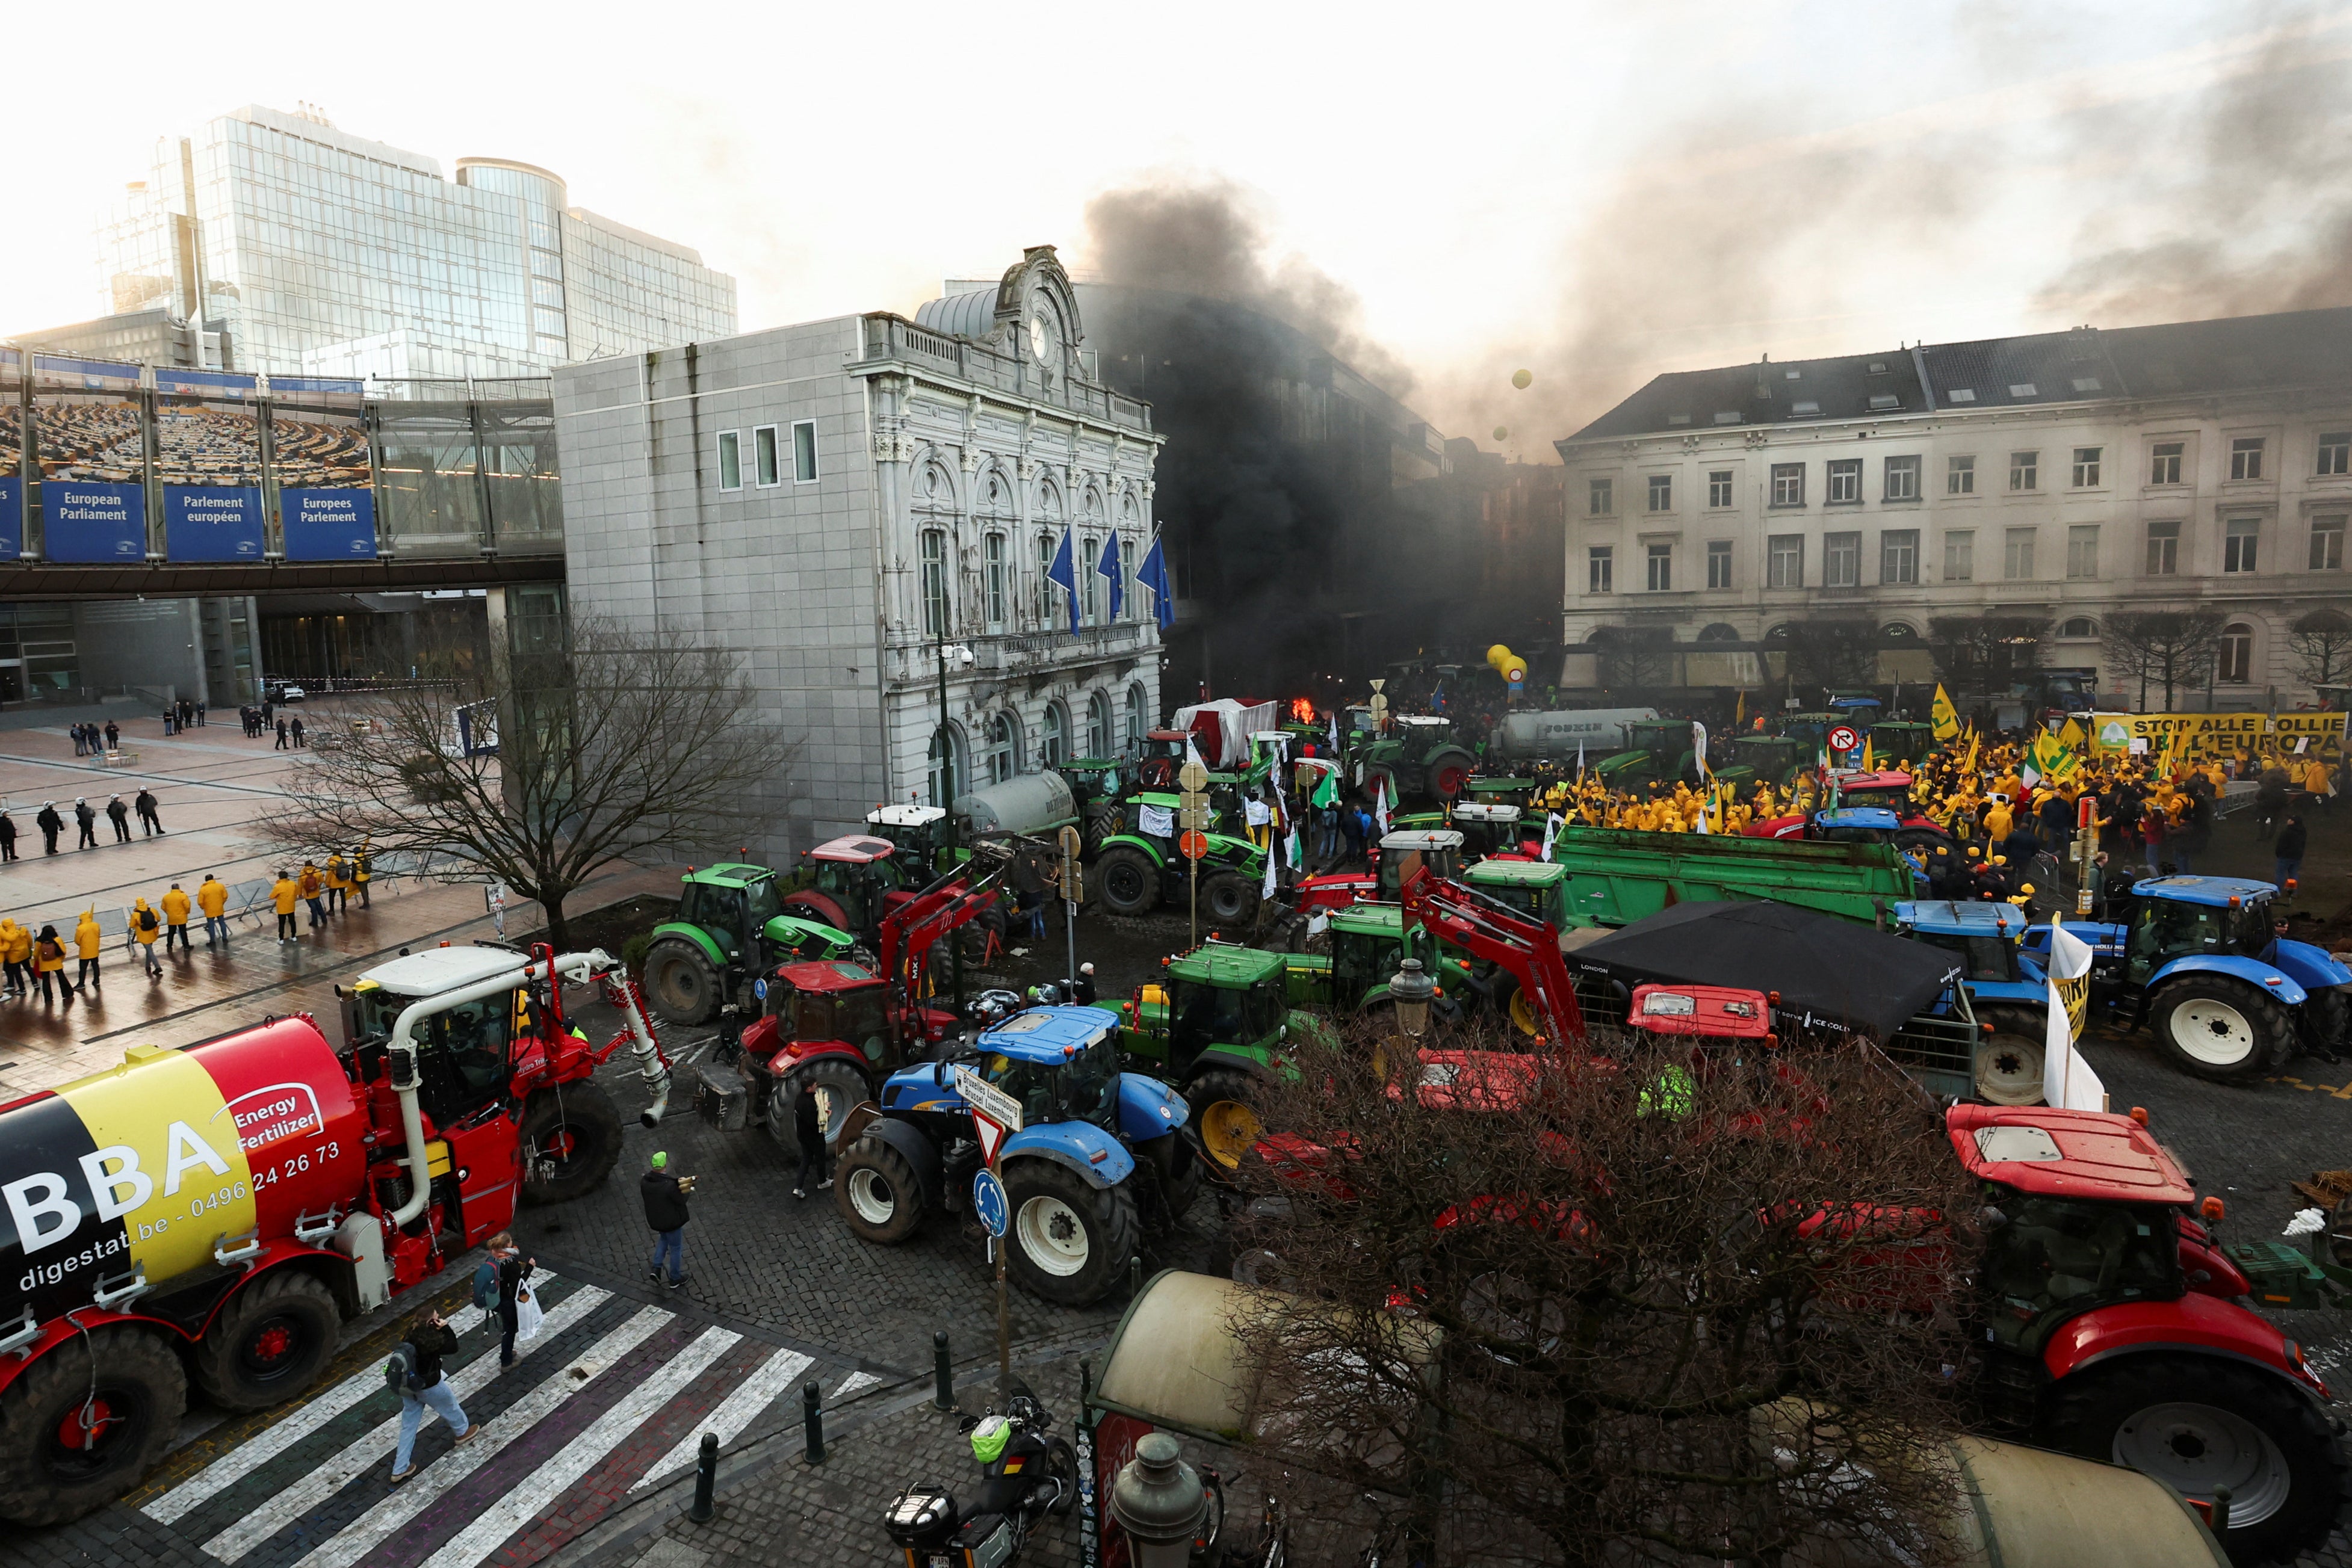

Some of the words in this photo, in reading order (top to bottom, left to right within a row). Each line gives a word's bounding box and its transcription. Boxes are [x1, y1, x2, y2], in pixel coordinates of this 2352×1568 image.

[64, 492, 121, 507] European
[184, 496, 243, 507] Parlement
[303, 498, 351, 510] Europees
[60, 507, 126, 520] Parliament
[187, 511, 241, 524] européen
[300, 511, 356, 522] Parlement
[2134, 719, 2191, 733] STOP
[2199, 719, 2255, 732] ALLE
[2264, 718, 2344, 732] OLLIE
[912, 961, 918, 980] MX
[1581, 964, 1608, 974] LONDON
[1781, 1011, 1803, 1020] serve
[1827, 1022, 1851, 1032] COLD
[964, 1073, 985, 1095] Bruxelles
[988, 1088, 1018, 1117] Luxembourg
[234, 1097, 296, 1128] Energy
[965, 1085, 983, 1105] Brussel
[985, 1098, 1013, 1126] Luxemburg
[236, 1113, 316, 1153] Fertilizer
[1, 1120, 231, 1255] BBA
[20, 1217, 169, 1292] digestat.be
[191, 1181, 247, 1218] 0496
[253, 1167, 279, 1192] 24
[285, 1154, 310, 1178] 26
[315, 1141, 339, 1164] 73
